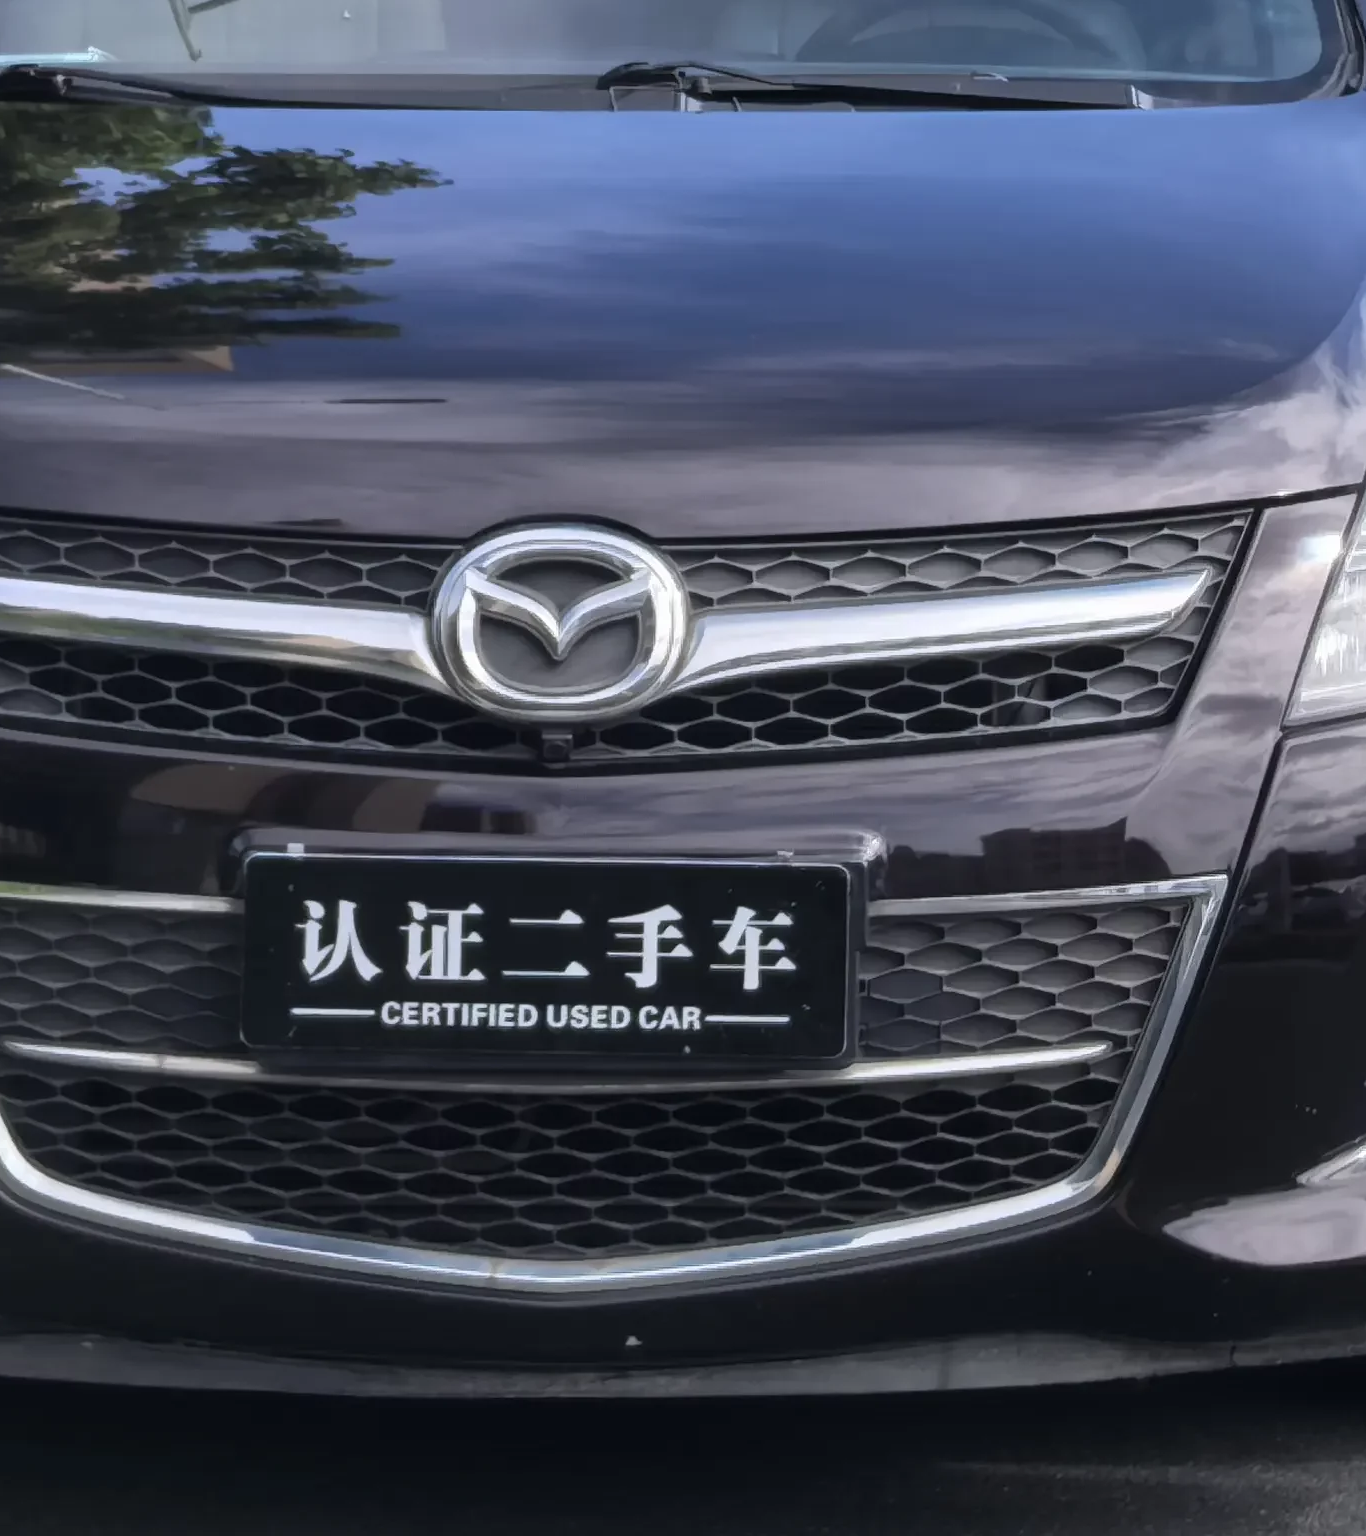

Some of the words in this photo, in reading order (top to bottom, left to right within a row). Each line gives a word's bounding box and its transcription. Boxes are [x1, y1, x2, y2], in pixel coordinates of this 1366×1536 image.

[295, 899, 798, 991] 认证二手车
[380, 1000, 539, 1029] CERTIFIED
[546, 1004, 631, 1030] USED
[638, 1005, 702, 1031] CAR
